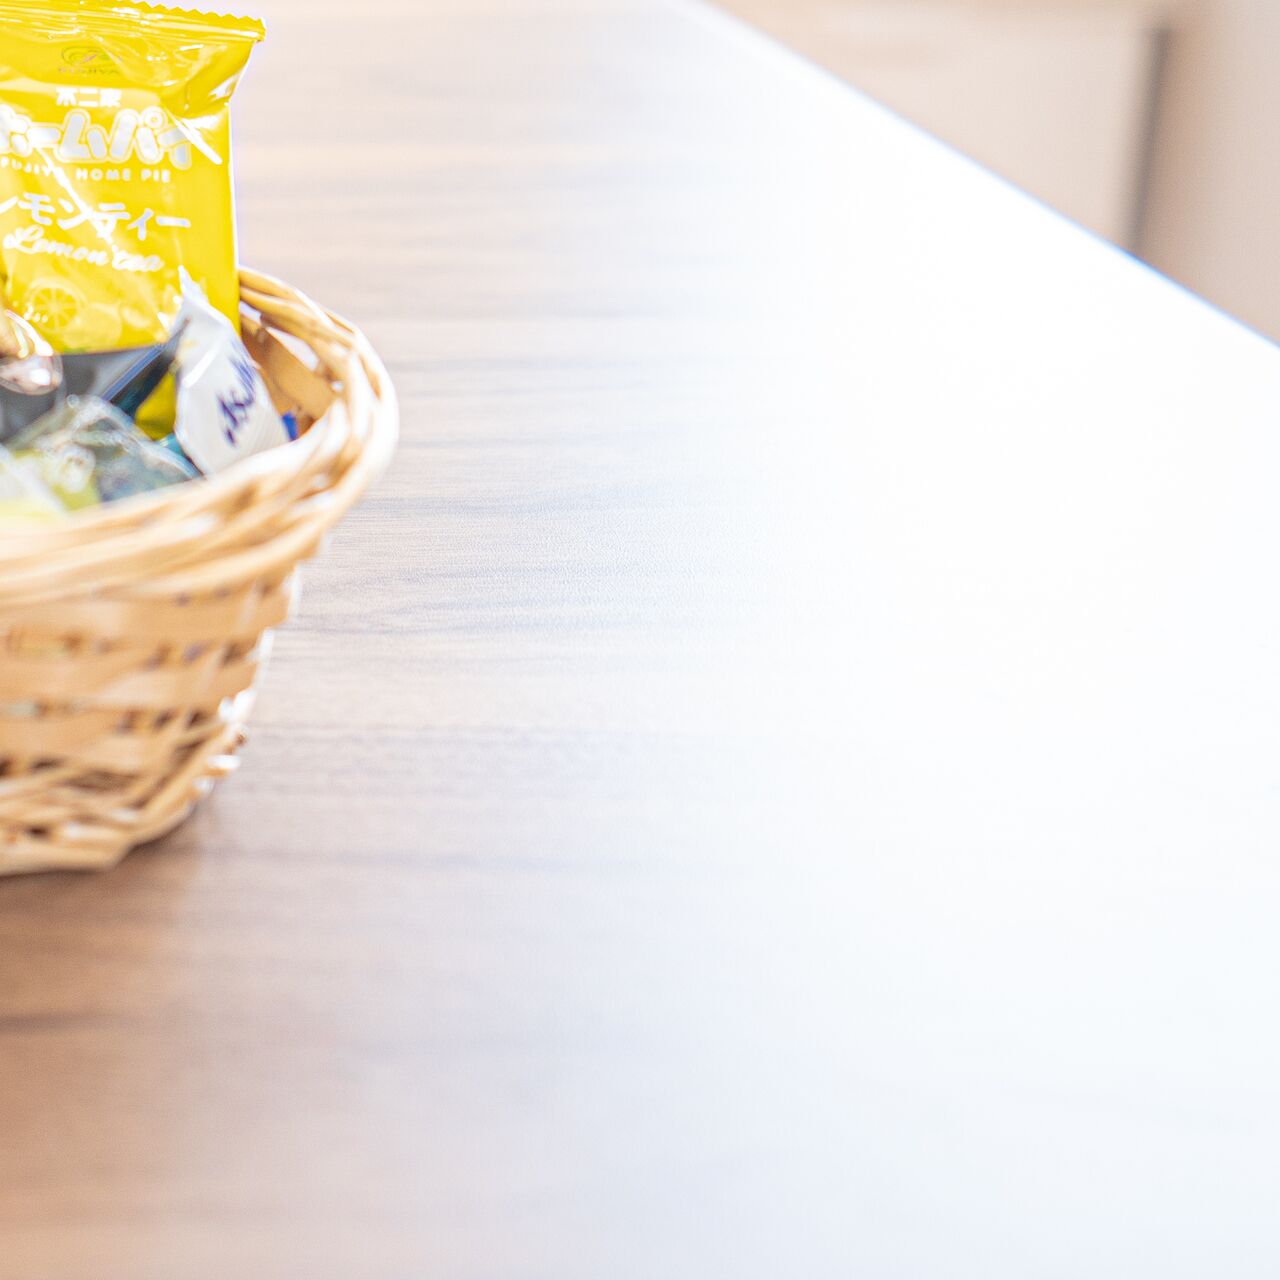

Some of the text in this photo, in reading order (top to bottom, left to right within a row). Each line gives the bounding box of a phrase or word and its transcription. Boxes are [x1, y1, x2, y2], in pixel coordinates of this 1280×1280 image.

[56, 87, 122, 108] 不二家
[76, 168, 131, 182] HOME
[141, 170, 171, 184] PIE
